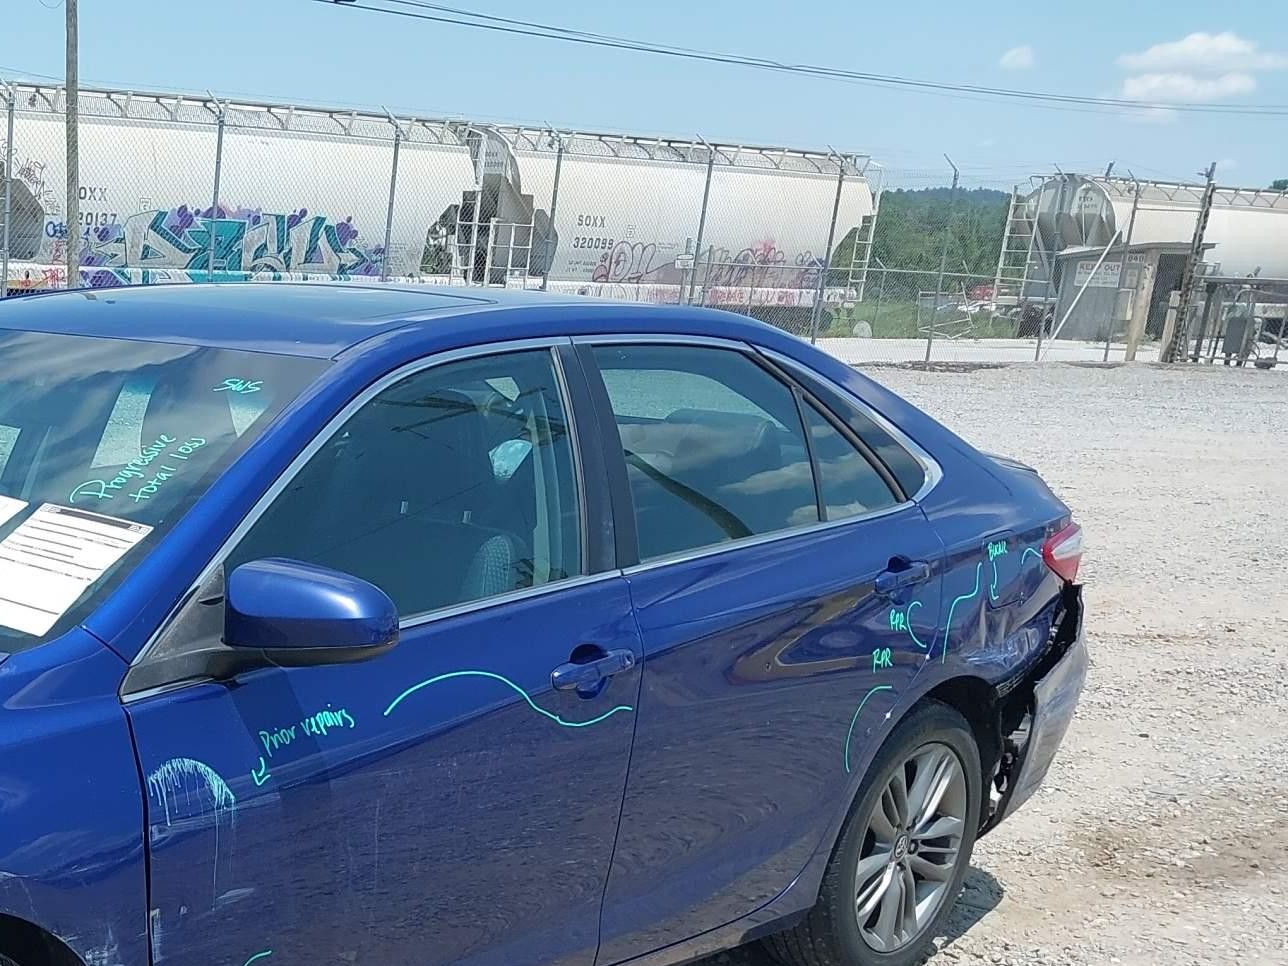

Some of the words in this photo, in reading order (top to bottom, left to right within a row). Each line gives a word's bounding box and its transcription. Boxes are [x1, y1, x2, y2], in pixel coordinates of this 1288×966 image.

[78, 186, 107, 201] OXX
[78, 212, 117, 226] 20137
[577, 214, 606, 228] SOXX
[69, 434, 177, 503] Progressive
[258, 727, 296, 758] Prior
[299, 703, 355, 736] repairs
